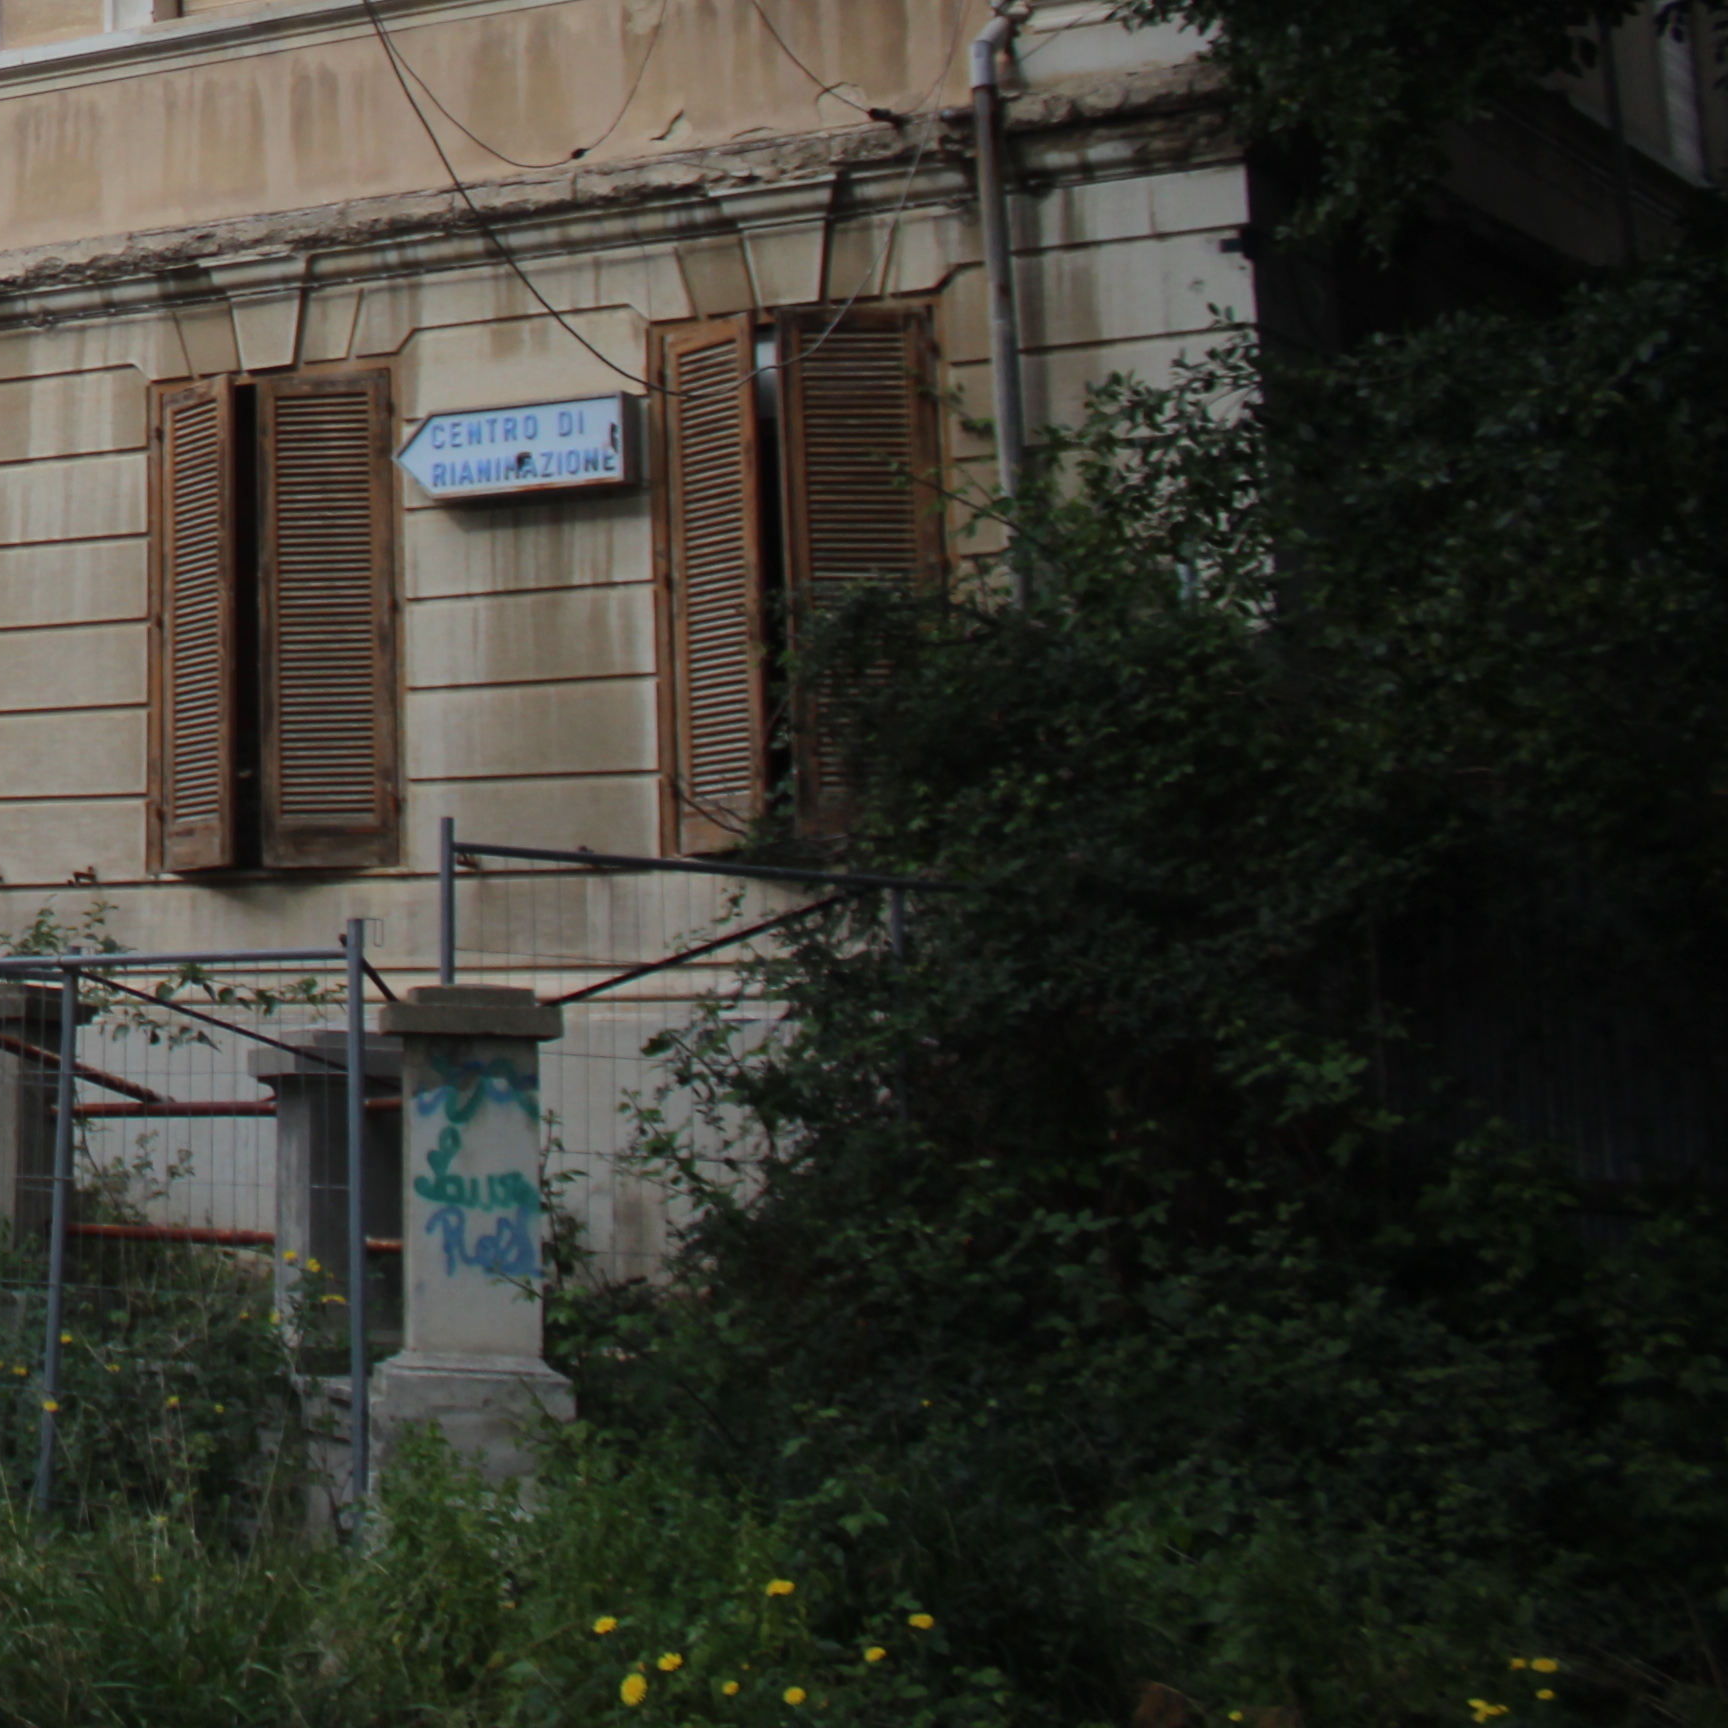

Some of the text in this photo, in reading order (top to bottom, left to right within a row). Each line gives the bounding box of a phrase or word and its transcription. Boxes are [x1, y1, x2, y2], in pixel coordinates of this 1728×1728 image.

[431, 409, 585, 449] CENTRO DI
[431, 445, 617, 488] RIANIMAZIONE
